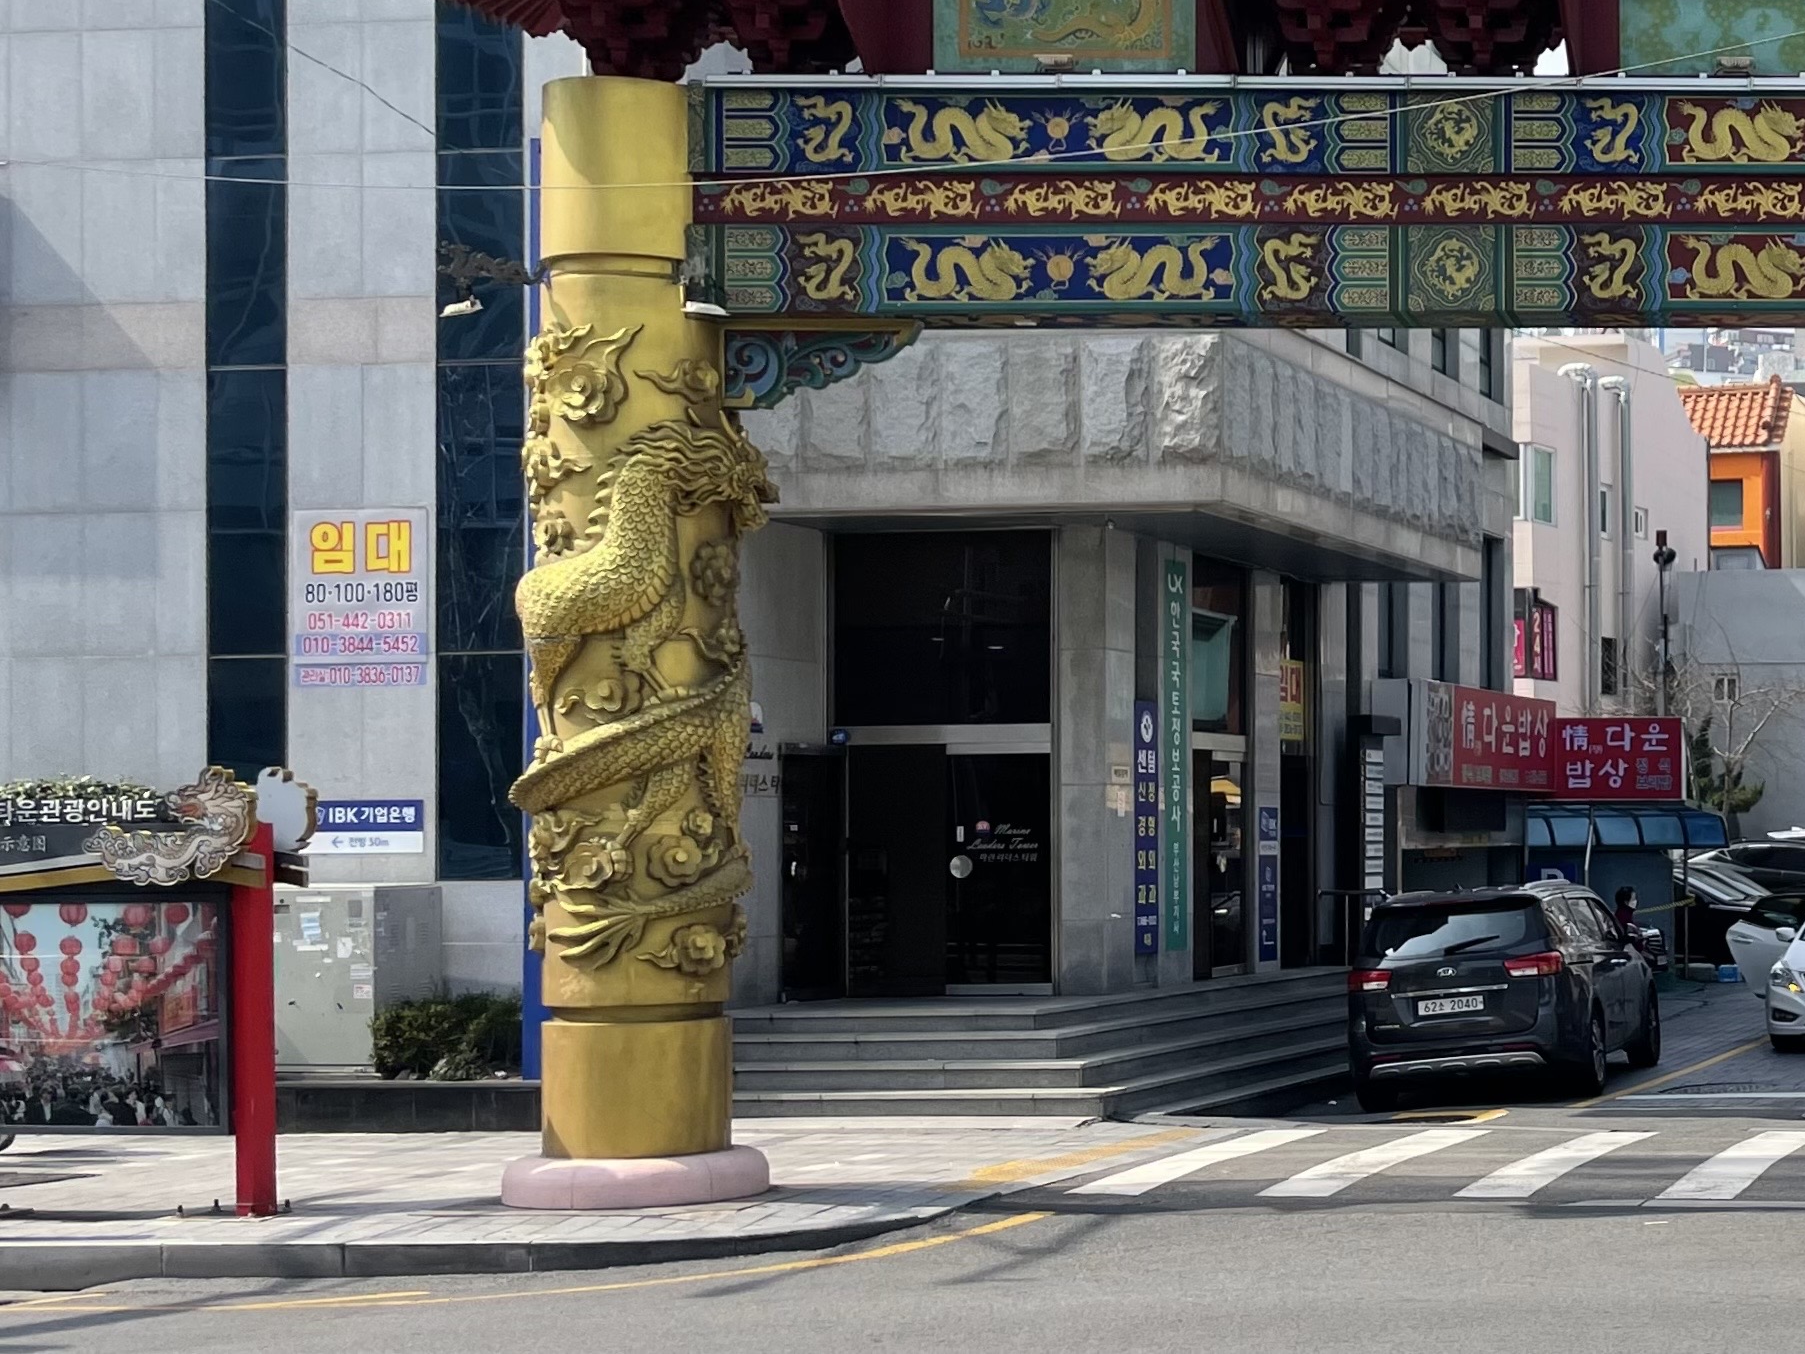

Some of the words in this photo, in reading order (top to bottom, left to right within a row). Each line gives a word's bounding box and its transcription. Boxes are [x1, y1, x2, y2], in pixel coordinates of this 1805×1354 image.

[310, 520, 411, 574] 임대
[308, 611, 411, 631] 051-442-0311
[1170, 600, 1182, 833] 한국국토정보공사
[329, 806, 358, 824] IBK
[360, 806, 415, 824] 기업은행
[1449, 997, 1479, 1012] 2040
